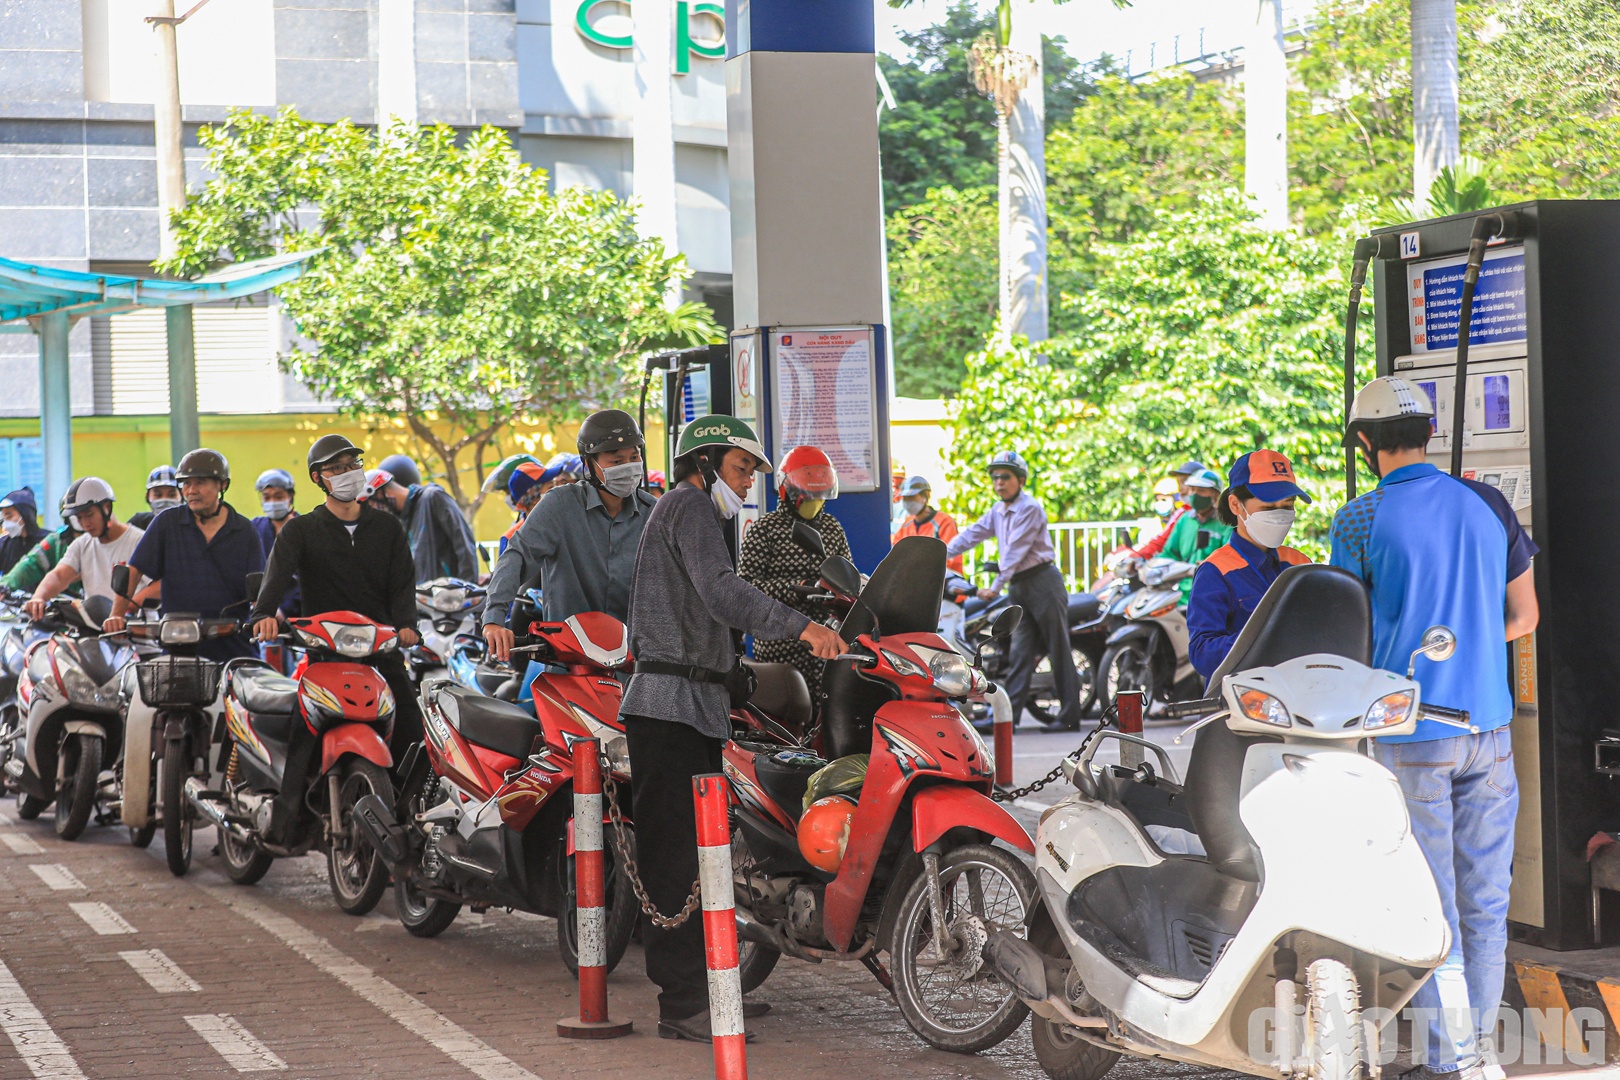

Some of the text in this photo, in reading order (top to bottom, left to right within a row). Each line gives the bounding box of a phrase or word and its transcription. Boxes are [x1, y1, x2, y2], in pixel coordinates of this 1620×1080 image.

[1403, 236, 1417, 255] 14
[693, 423, 731, 438] Grab
[597, 680, 621, 689] HONDA
[530, 770, 552, 784] HONDA
